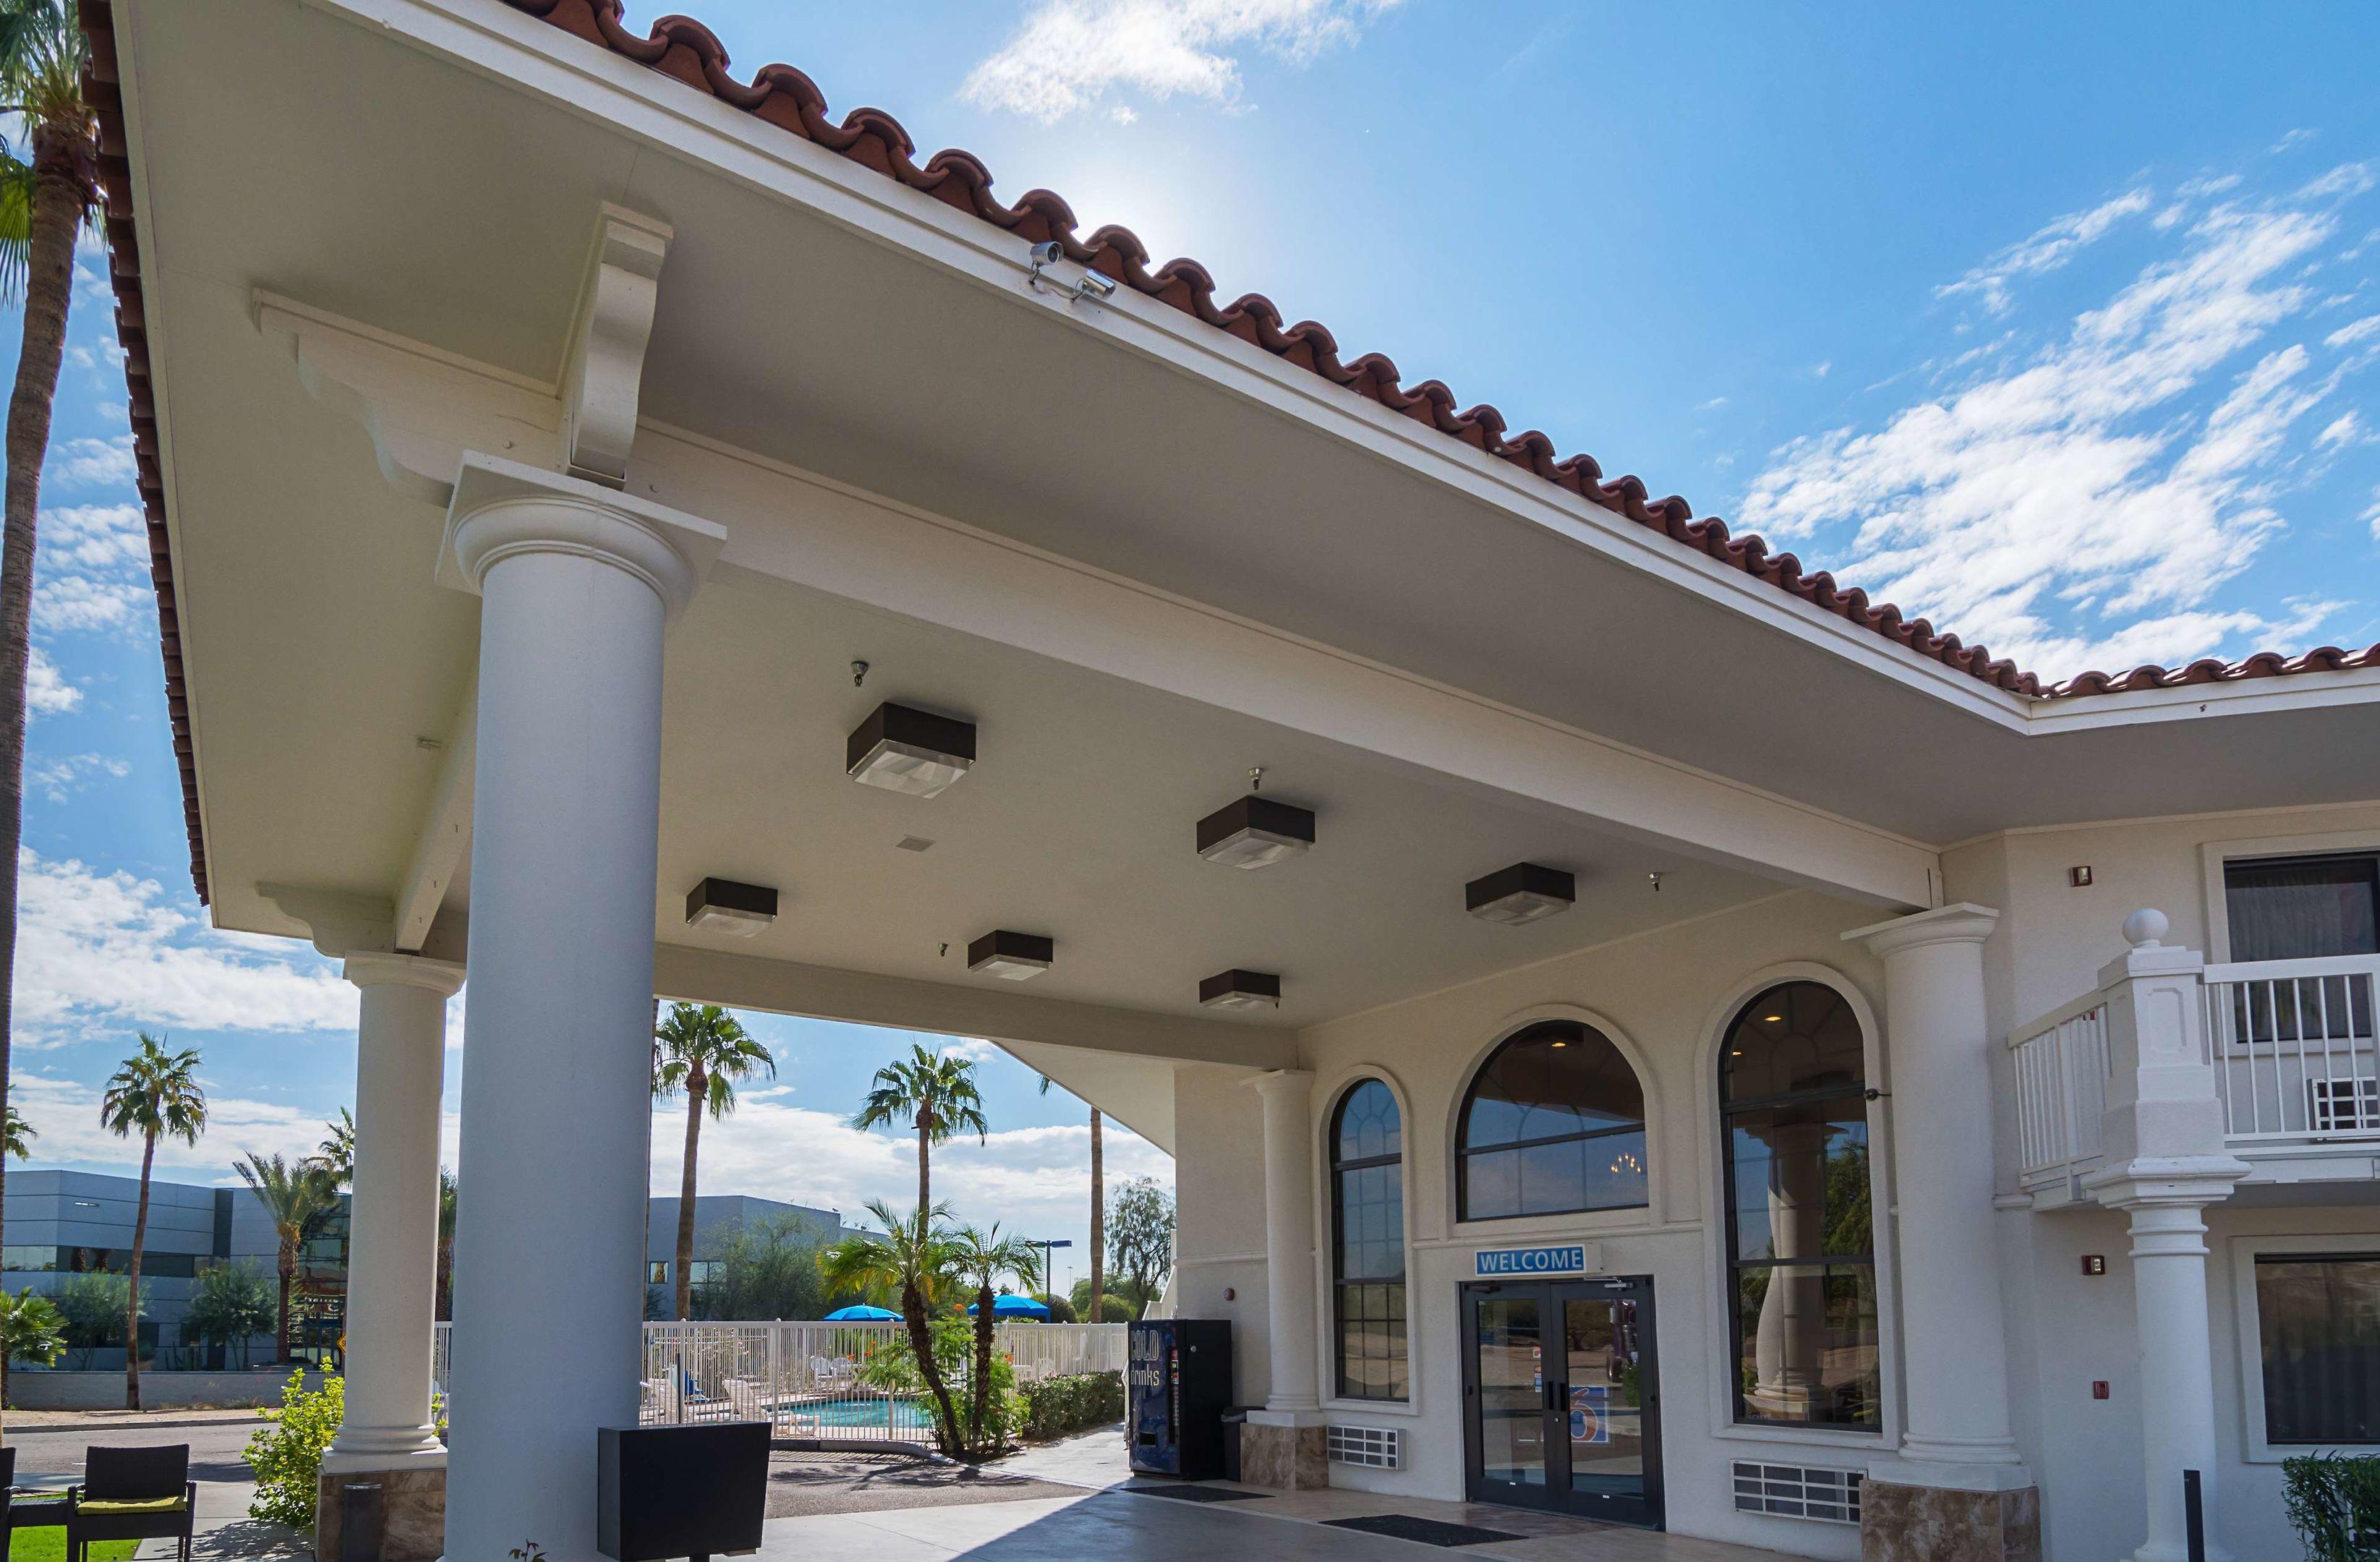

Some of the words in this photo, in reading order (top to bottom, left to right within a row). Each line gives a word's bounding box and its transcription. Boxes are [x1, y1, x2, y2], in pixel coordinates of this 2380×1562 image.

[1480, 1250, 1582, 1271] WELCOME
[1131, 1330, 1159, 1361] COLD
[1130, 1362, 1159, 1386] drinks
[1569, 1388, 1598, 1442] 6
